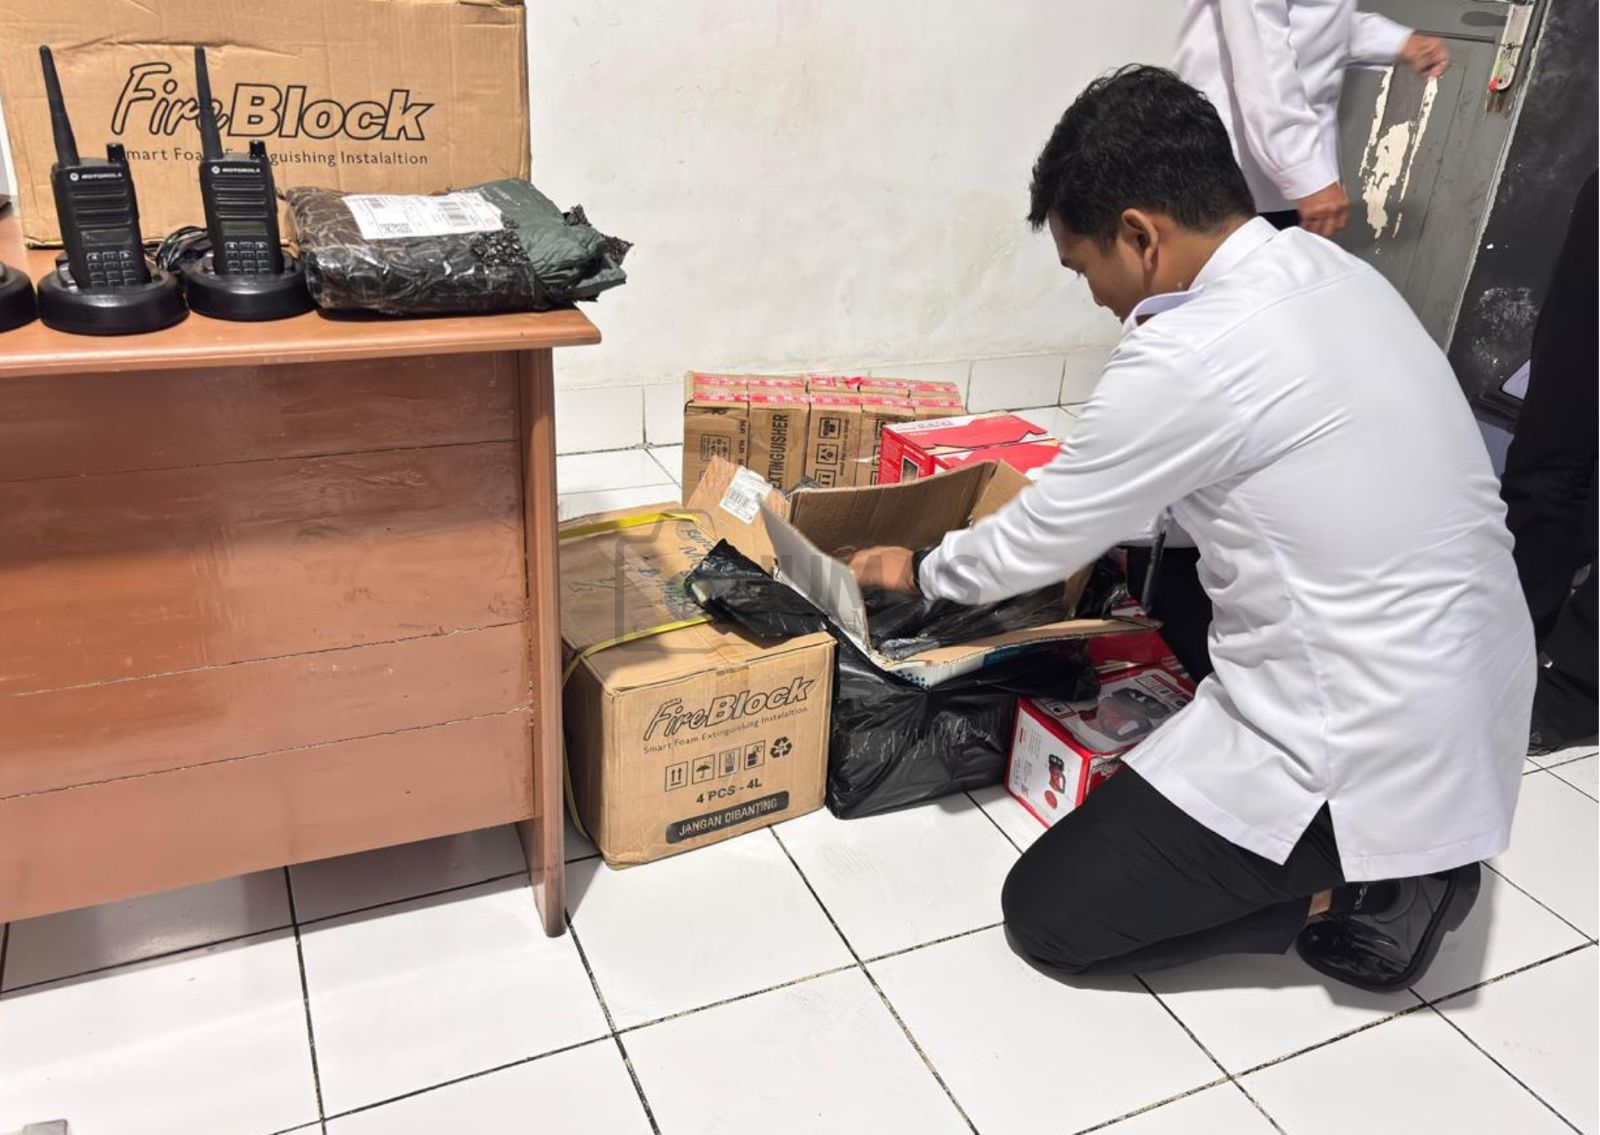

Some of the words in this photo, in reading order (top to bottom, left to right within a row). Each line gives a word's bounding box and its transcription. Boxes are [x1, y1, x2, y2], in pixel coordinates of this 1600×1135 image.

[125, 148, 169, 161] mart
[173, 147, 205, 161] Foa
[340, 151, 428, 165] Instalaltion
[642, 676, 815, 742] FireBlock
[643, 741, 672, 754] Smart
[674, 736, 699, 747] Foam
[701, 719, 760, 741] Extinguishing
[696, 794, 705, 804] 4
[708, 785, 736, 802] PCS
[747, 777, 763, 790] 4L
[678, 810, 723, 837] JANGAN
[724, 797, 778, 823] DIBANTING
